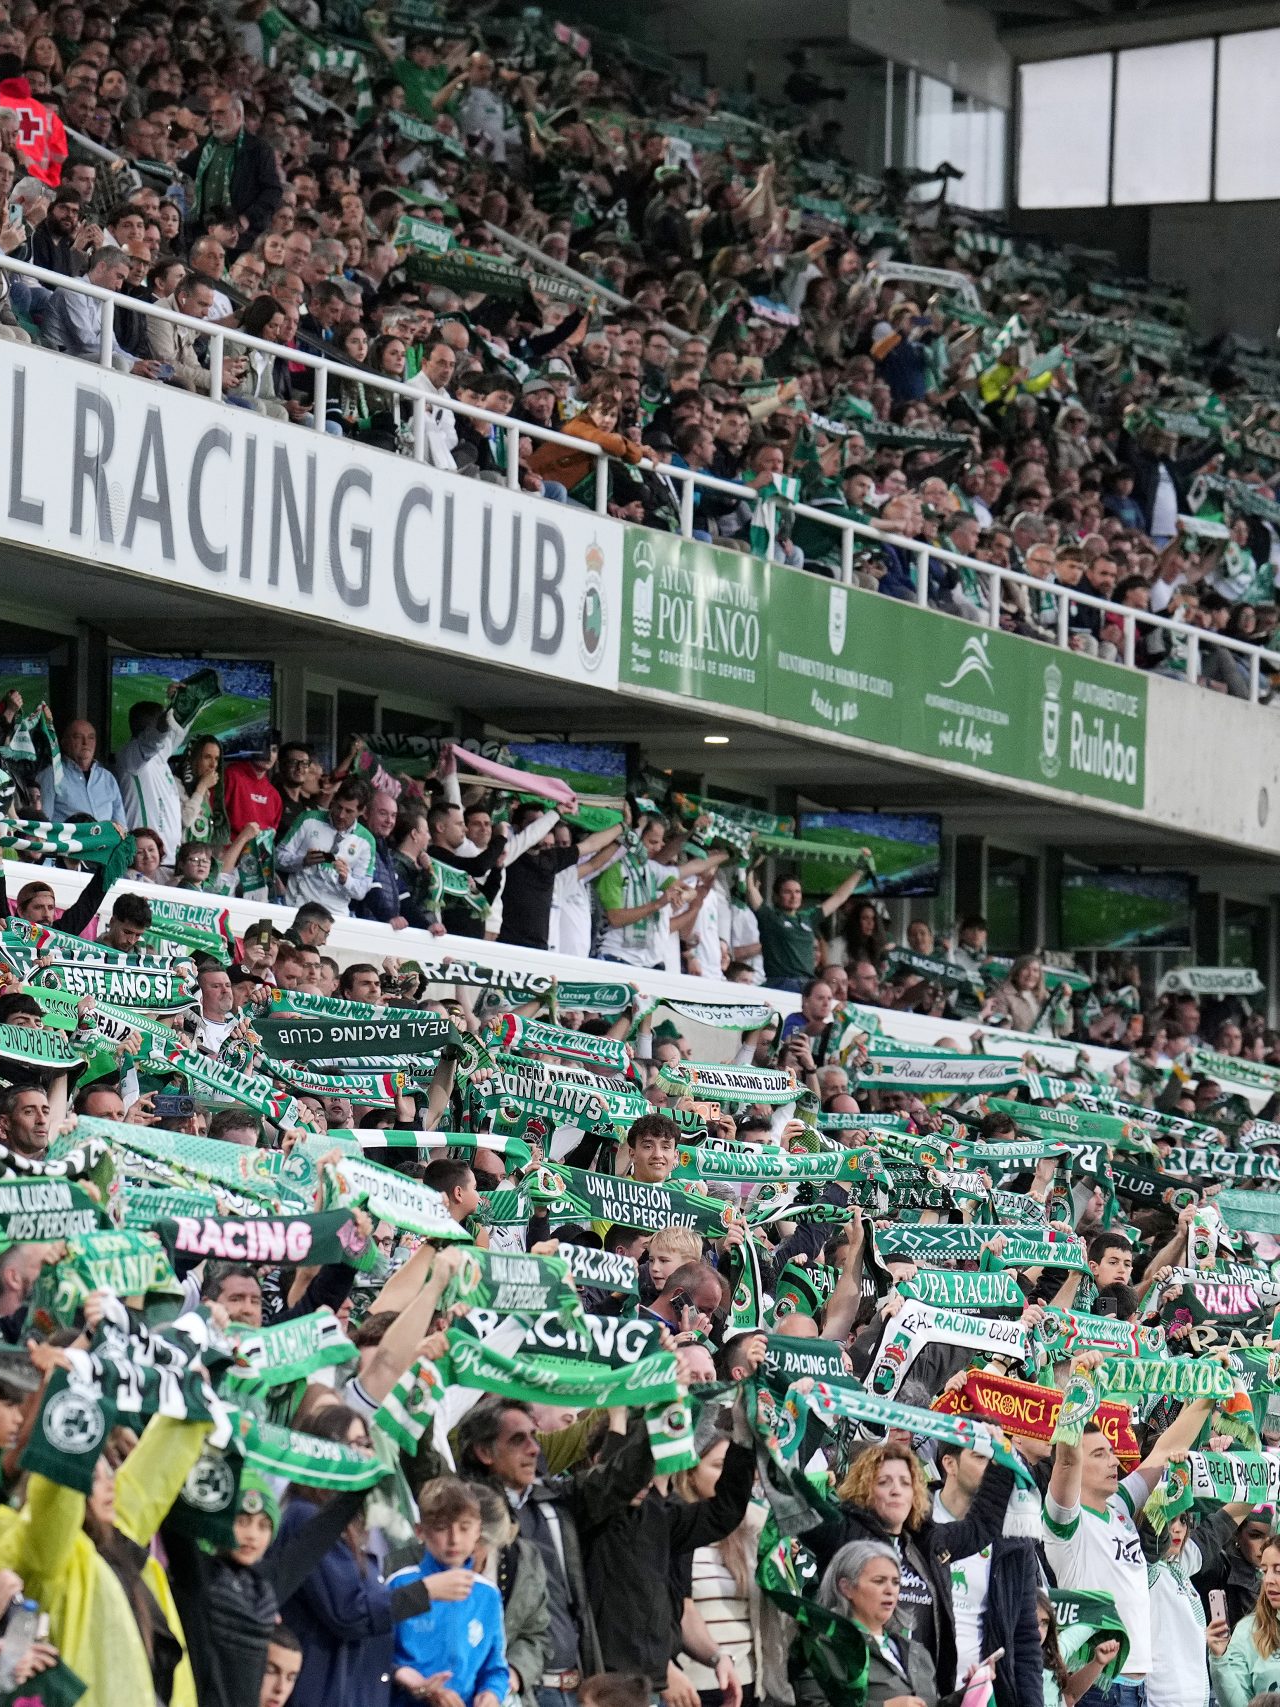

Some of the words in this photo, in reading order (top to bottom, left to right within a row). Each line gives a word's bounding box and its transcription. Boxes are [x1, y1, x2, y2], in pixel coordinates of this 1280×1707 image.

[70, 381, 373, 608] RACING
[393, 481, 566, 656] CLUB
[657, 592, 760, 662] POLANCO
[707, 660, 717, 675] DE
[719, 662, 756, 685] DEPORTES
[1070, 710, 1138, 786] Ruiloba
[186, 907, 214, 925] CLUB
[65, 967, 106, 996] ESTE
[108, 967, 152, 998] AÑO
[153, 972, 172, 999] SÍ
[422, 961, 552, 994] RACING
[597, 986, 619, 1002] Club
[3, 1024, 42, 1056] RACING
[279, 1027, 323, 1045] CLUB
[331, 1025, 403, 1043] RACING
[410, 1020, 450, 1038] REAL
[525, 1023, 562, 1045] CLUB
[42, 1030, 72, 1059] REAL
[564, 1032, 622, 1060] RACING
[184, 1049, 271, 1101] RACING
[331, 1074, 374, 1089] CLUB
[699, 1071, 727, 1087] REAL
[728, 1073, 763, 1089] RACING
[764, 1075, 788, 1091] CLUB
[893, 1060, 930, 1079] Real
[932, 1063, 975, 1082] Racing
[977, 1063, 1005, 1080] Club
[474, 1072, 604, 1121] SANTANDER
[500, 1097, 580, 1129] RACING
[827, 1113, 893, 1126] RACING
[1074, 1097, 1117, 1116] REAL
[1118, 1104, 1184, 1134] RACING
[973, 1141, 1045, 1156] SANTANDER
[701, 1151, 782, 1177] SANTANDER
[787, 1152, 837, 1179] RACING
[379, 1180, 423, 1214] RACING
[586, 1175, 614, 1201] UNA
[617, 1184, 672, 1209] ILUSIÓN
[1112, 1172, 1155, 1197] CLUB
[601, 1203, 630, 1223] NOS
[631, 1206, 698, 1233] PERSIGUE
[175, 1216, 313, 1262] RACING
[557, 1242, 635, 1289] RACING
[954, 1275, 1018, 1304] RACING
[735, 1315, 750, 1325] 1913
[902, 1311, 933, 1335] REAL
[934, 1312, 987, 1337] RACING
[988, 1326, 1019, 1344] CLUB
[449, 1337, 513, 1386] Real
[515, 1364, 620, 1405] Racing
[625, 1357, 679, 1389] Club
[783, 1352, 828, 1375] RACING
[1195, 1456, 1209, 1489] 1913
[1210, 1458, 1235, 1484] REAL
[1237, 1461, 1277, 1488] RACING
